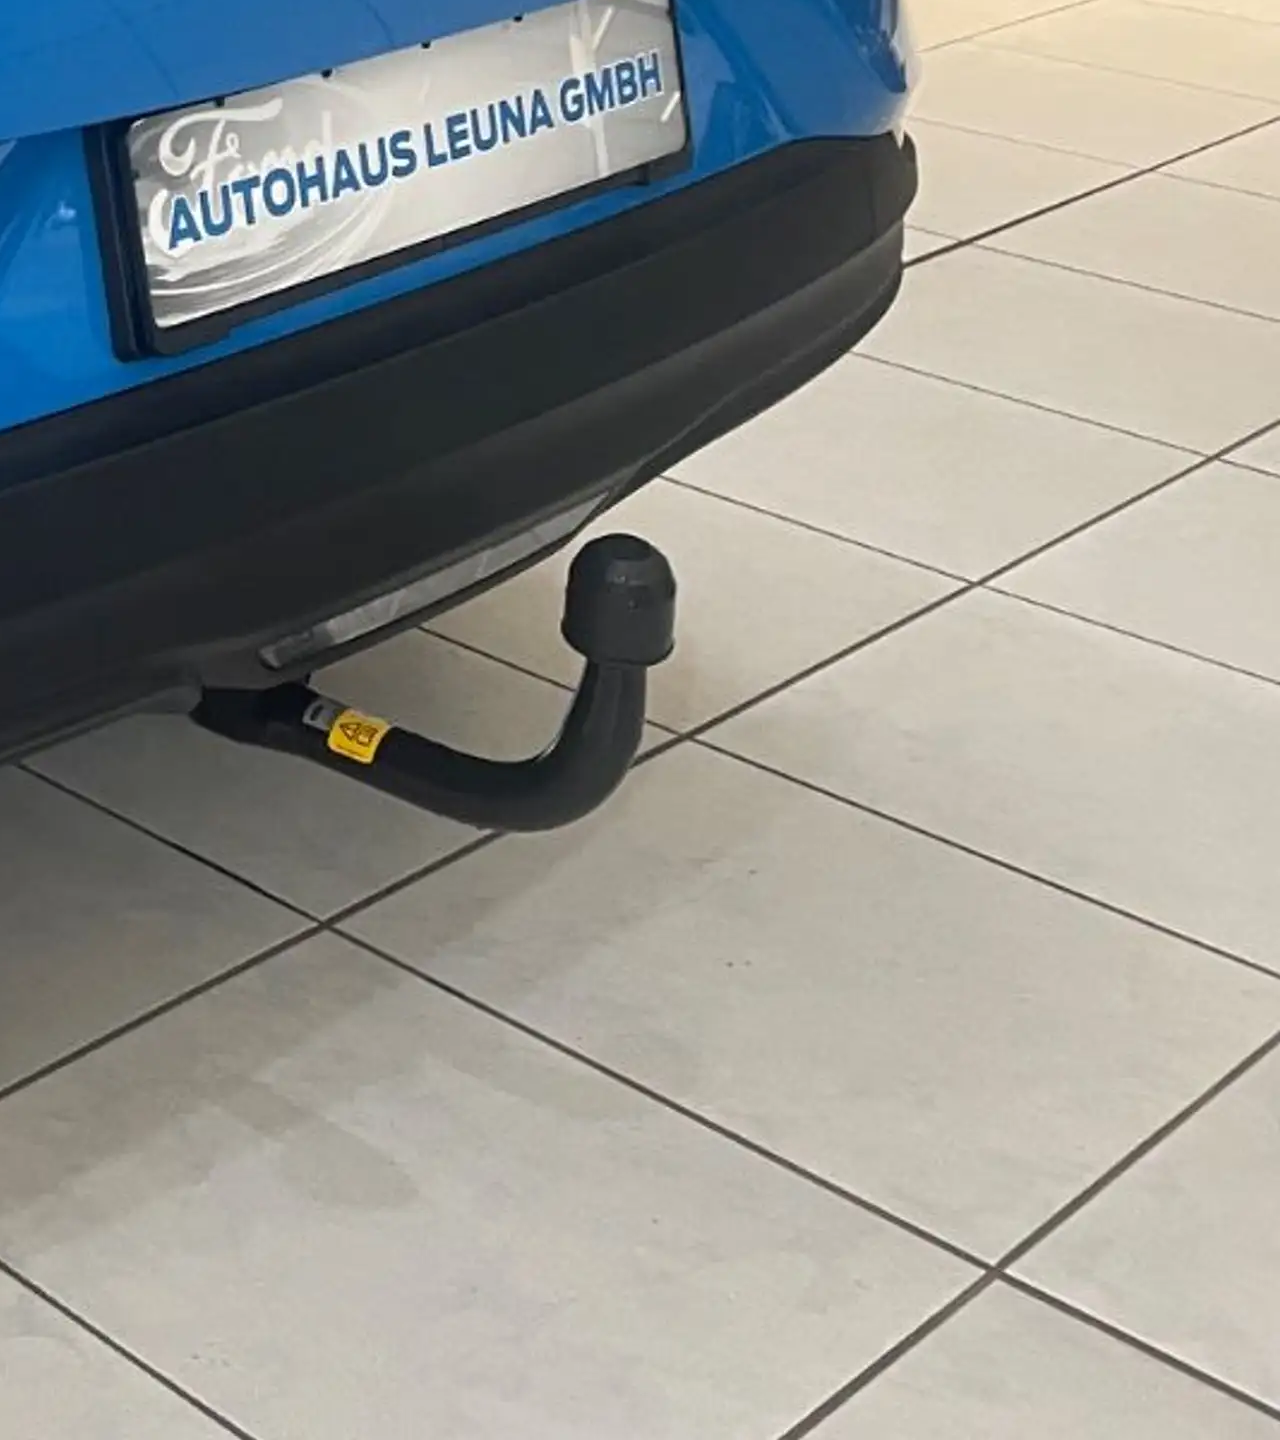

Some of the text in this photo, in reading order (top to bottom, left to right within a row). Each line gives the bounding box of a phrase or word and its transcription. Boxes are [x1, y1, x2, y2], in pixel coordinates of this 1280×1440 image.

[166, 50, 664, 252] AUTOHAUS LEUNA GMBH
